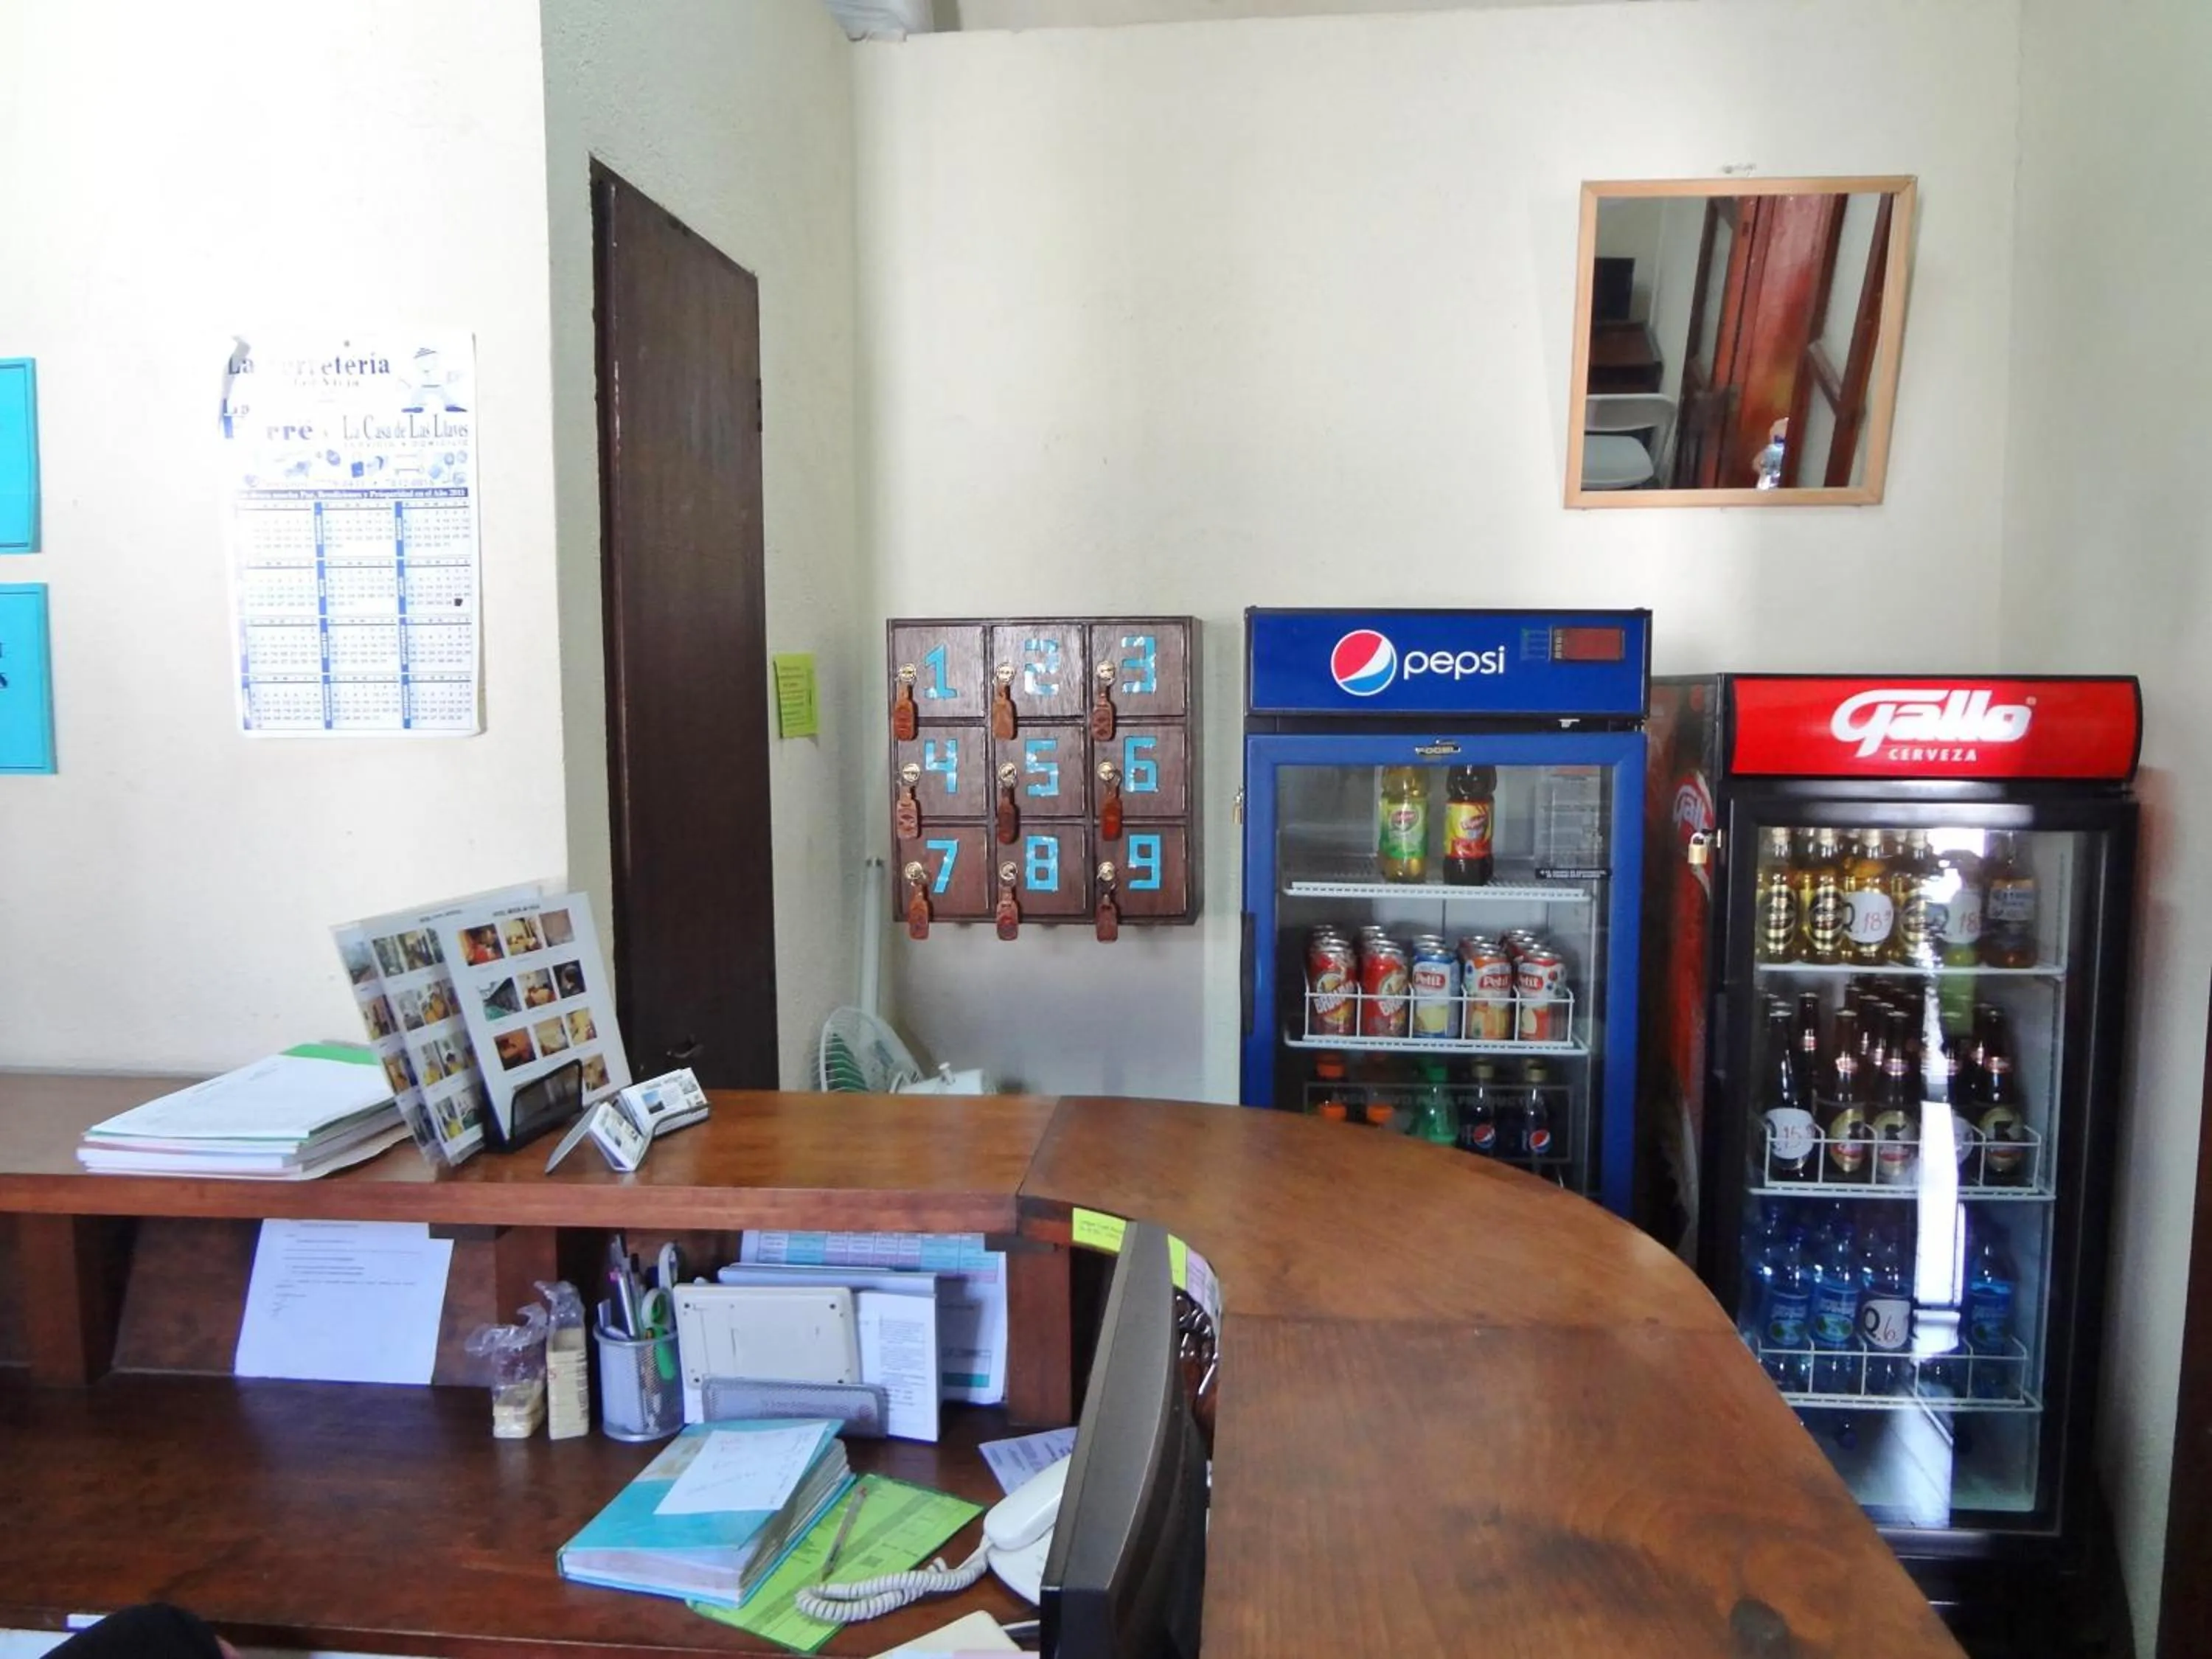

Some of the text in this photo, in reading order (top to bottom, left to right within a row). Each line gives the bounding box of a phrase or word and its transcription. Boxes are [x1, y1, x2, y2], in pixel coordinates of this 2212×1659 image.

[924, 644, 957, 700] 1
[1024, 638, 1059, 695] 2
[1121, 635, 1156, 695] 3
[1403, 645, 1505, 681] pepsi
[1830, 689, 2033, 758] Gallo
[925, 739, 958, 795] 4
[1025, 738, 1060, 796] 5
[1124, 736, 1158, 793] 6
[1888, 748, 1978, 762] CERVEZA
[926, 839, 959, 893] 7
[1026, 835, 1059, 891] 8
[1128, 834, 1161, 889] 9
